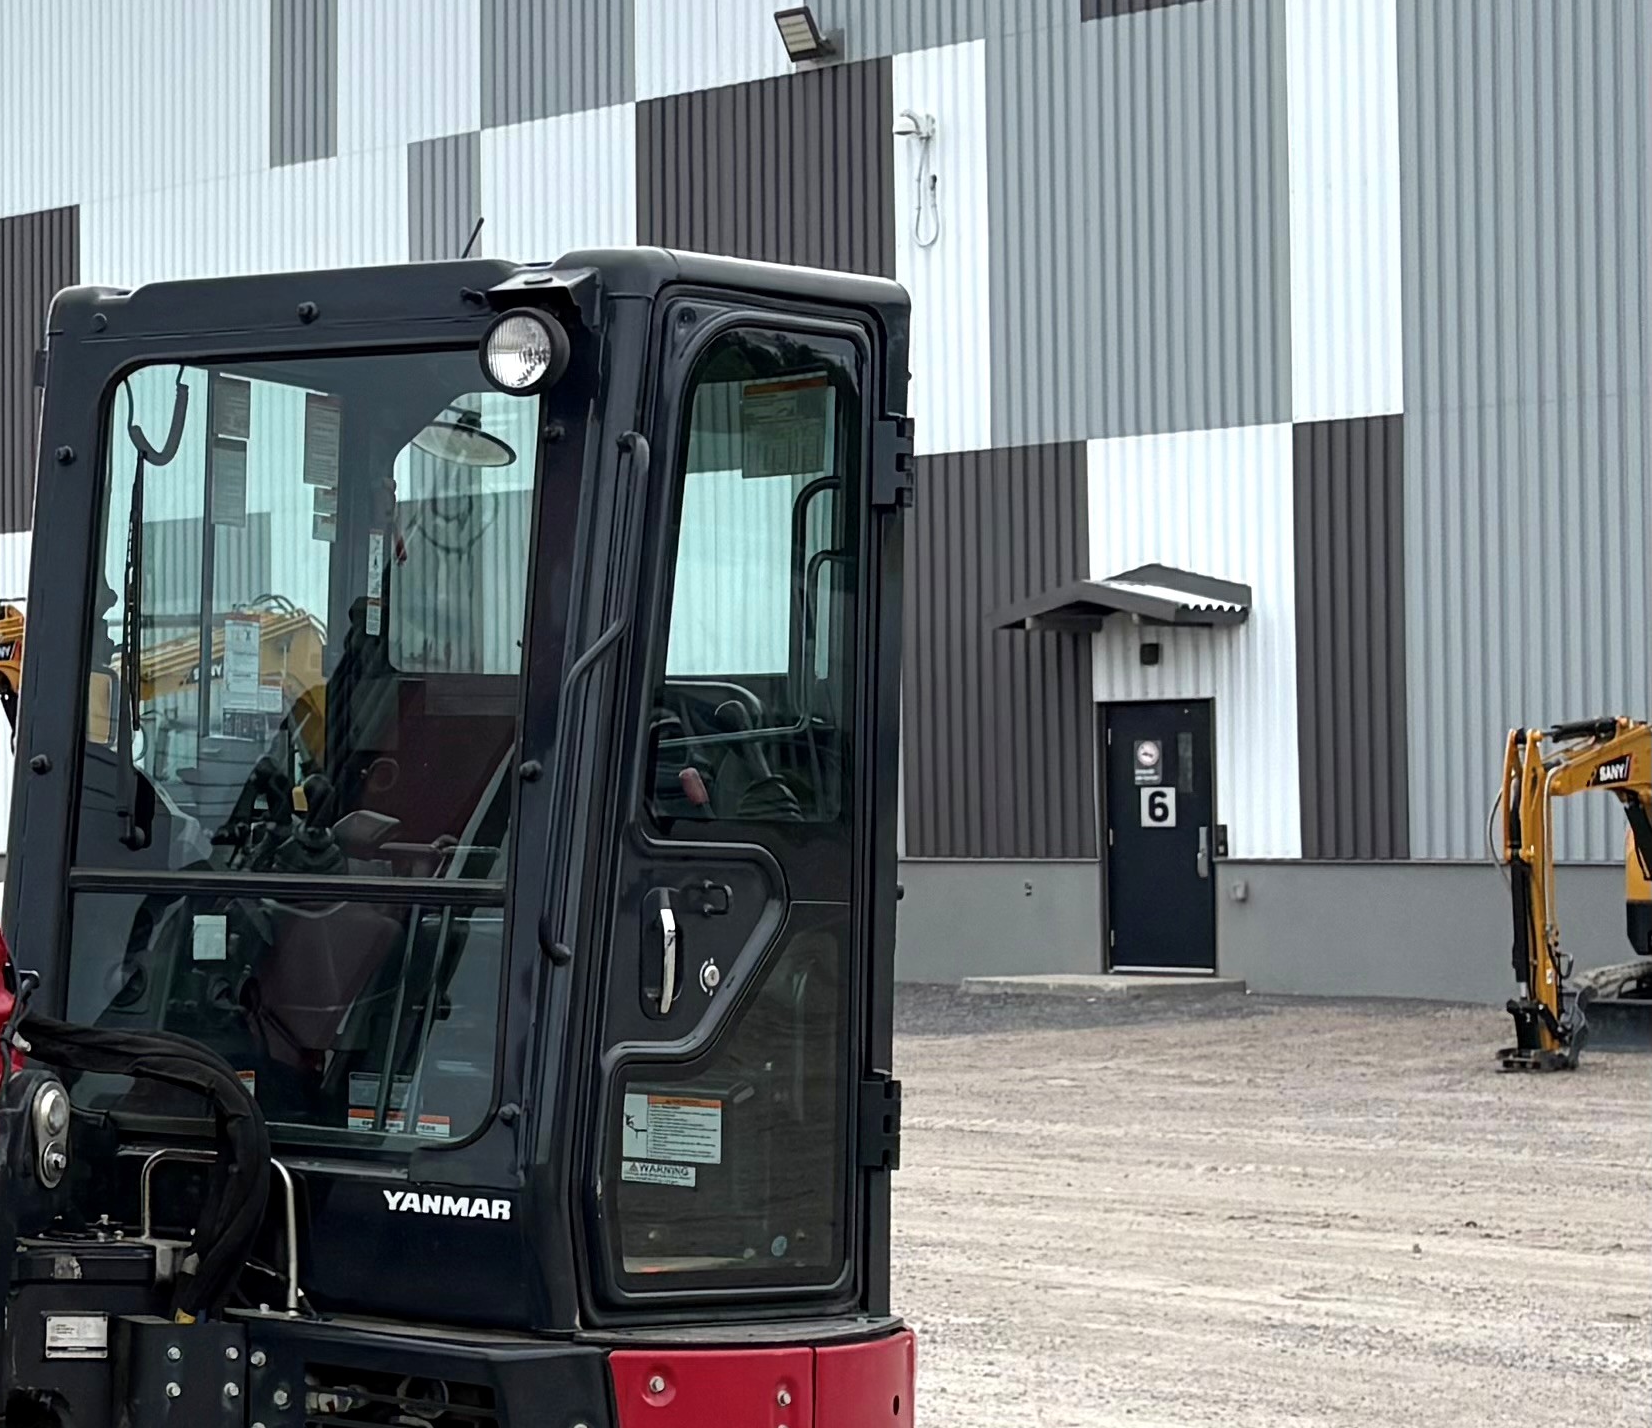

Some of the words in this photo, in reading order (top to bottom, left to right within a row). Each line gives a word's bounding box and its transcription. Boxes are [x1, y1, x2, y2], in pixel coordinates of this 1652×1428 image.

[1599, 763, 1626, 781] SANY
[1148, 790, 1170, 823] 6
[640, 1164, 689, 1176] WARNING
[381, 1188, 512, 1222] YANMAR
